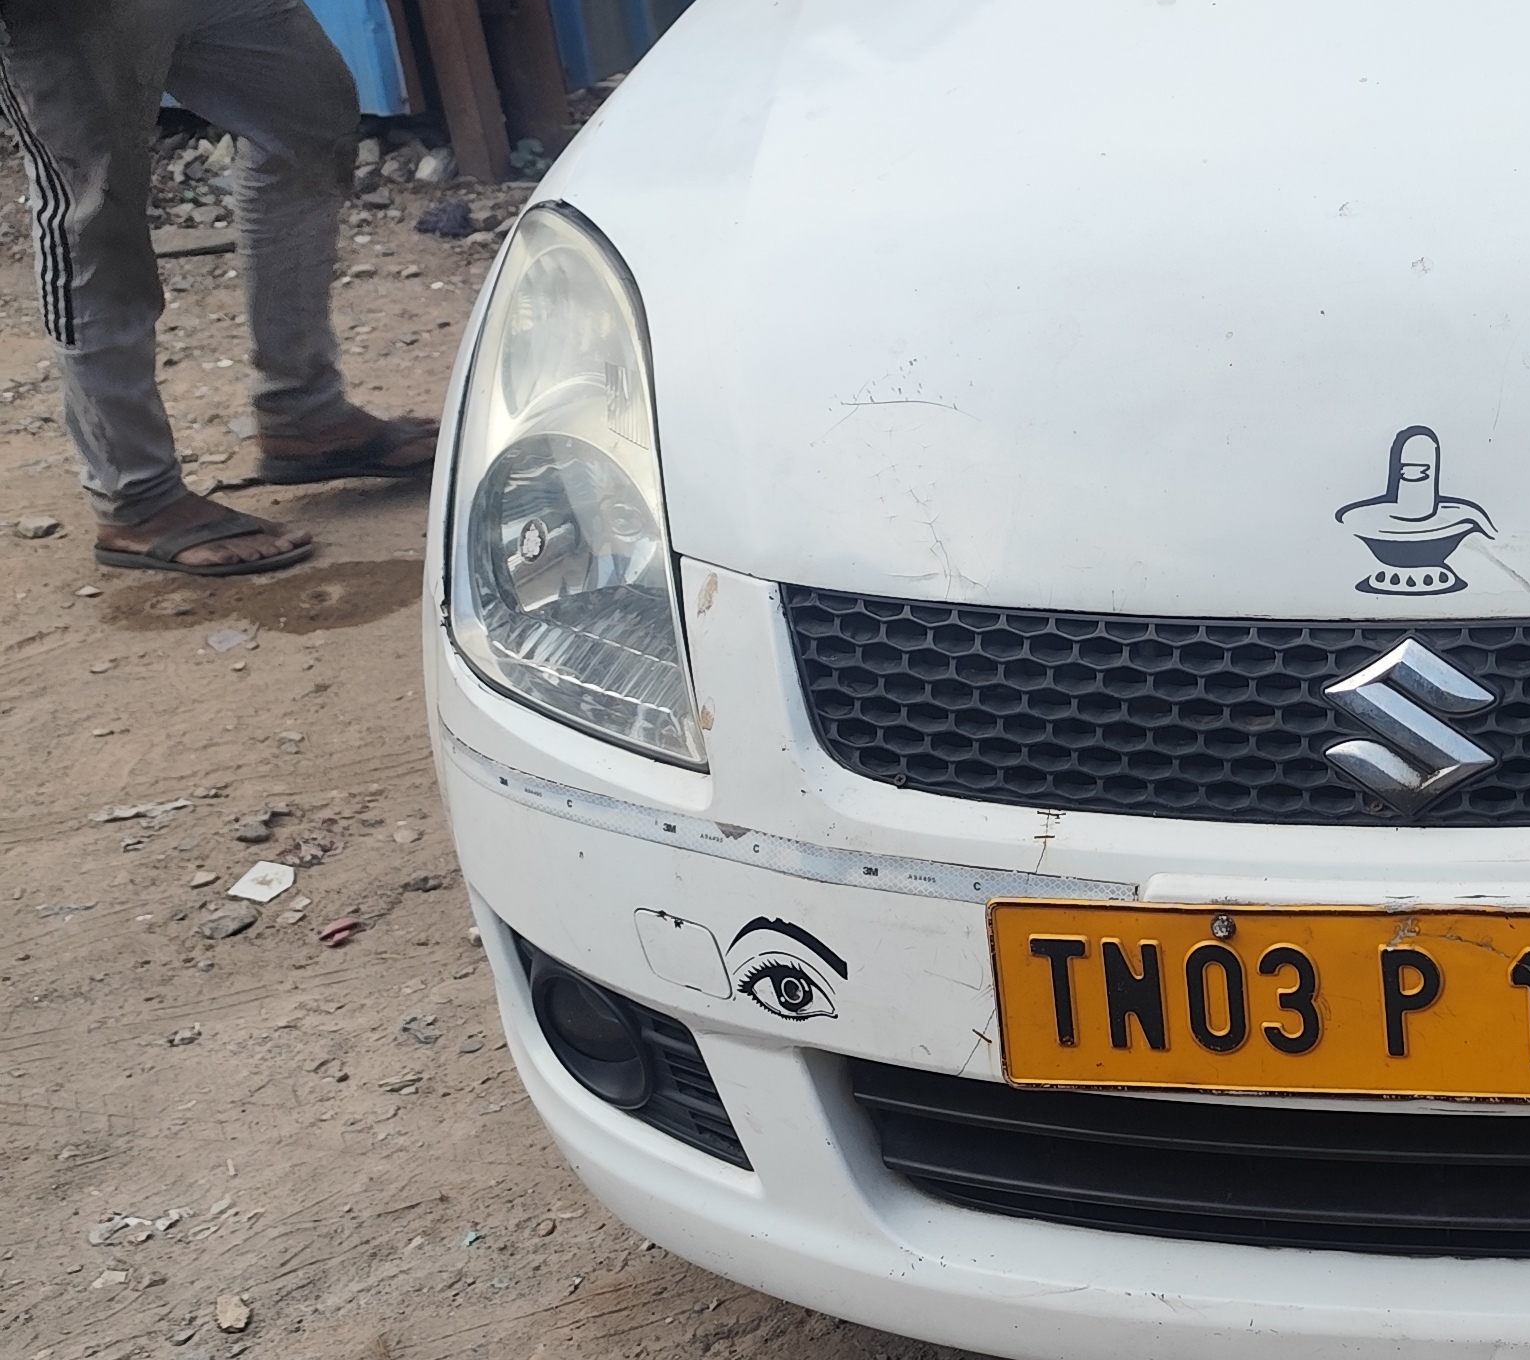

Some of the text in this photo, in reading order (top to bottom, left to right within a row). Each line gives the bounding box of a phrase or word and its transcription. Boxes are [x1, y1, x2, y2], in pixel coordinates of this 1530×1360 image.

[662, 822, 676, 833] 3M
[752, 844, 760, 853] C
[862, 866, 878, 877] 3M
[973, 881, 982, 891] C
[1029, 936, 1322, 1056] TN03
[1381, 945, 1443, 1058] P
